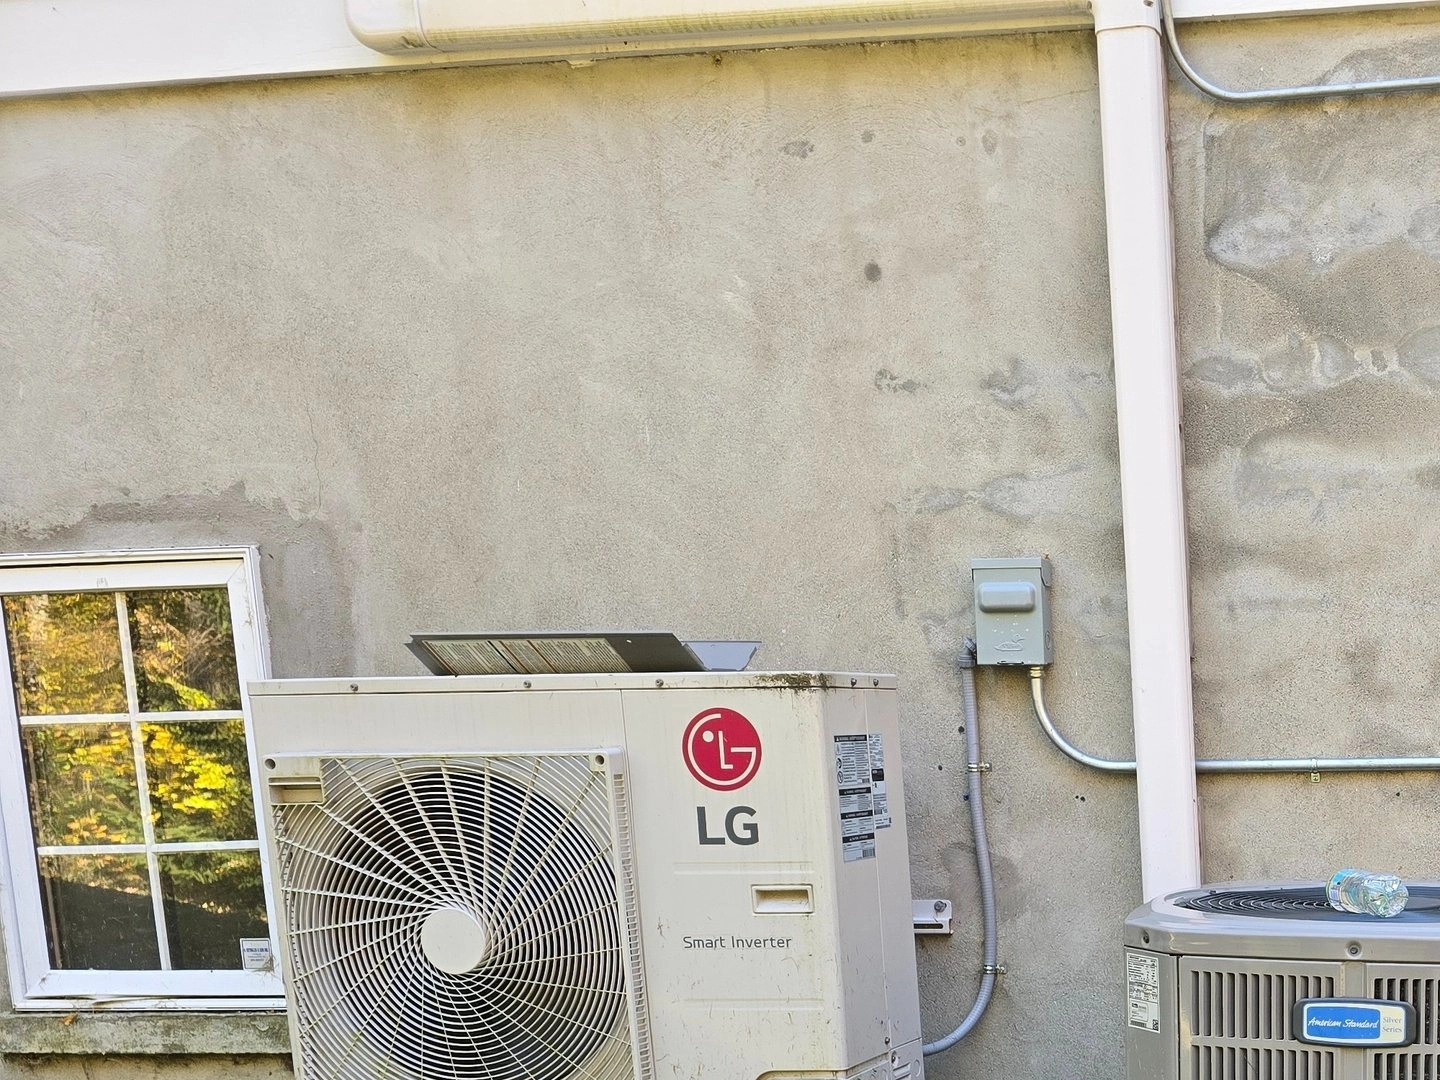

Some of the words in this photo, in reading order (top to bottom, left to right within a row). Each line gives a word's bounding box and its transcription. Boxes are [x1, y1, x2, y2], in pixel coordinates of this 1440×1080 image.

[697, 805, 760, 846] LG
[682, 935, 726, 949] Smart
[731, 935, 792, 949] Inverter
[1307, 1016, 1341, 1028] American
[1342, 1018, 1379, 1029] Standard
[1383, 1016, 1402, 1024] Silver
[1382, 1026, 1403, 1034] Series
